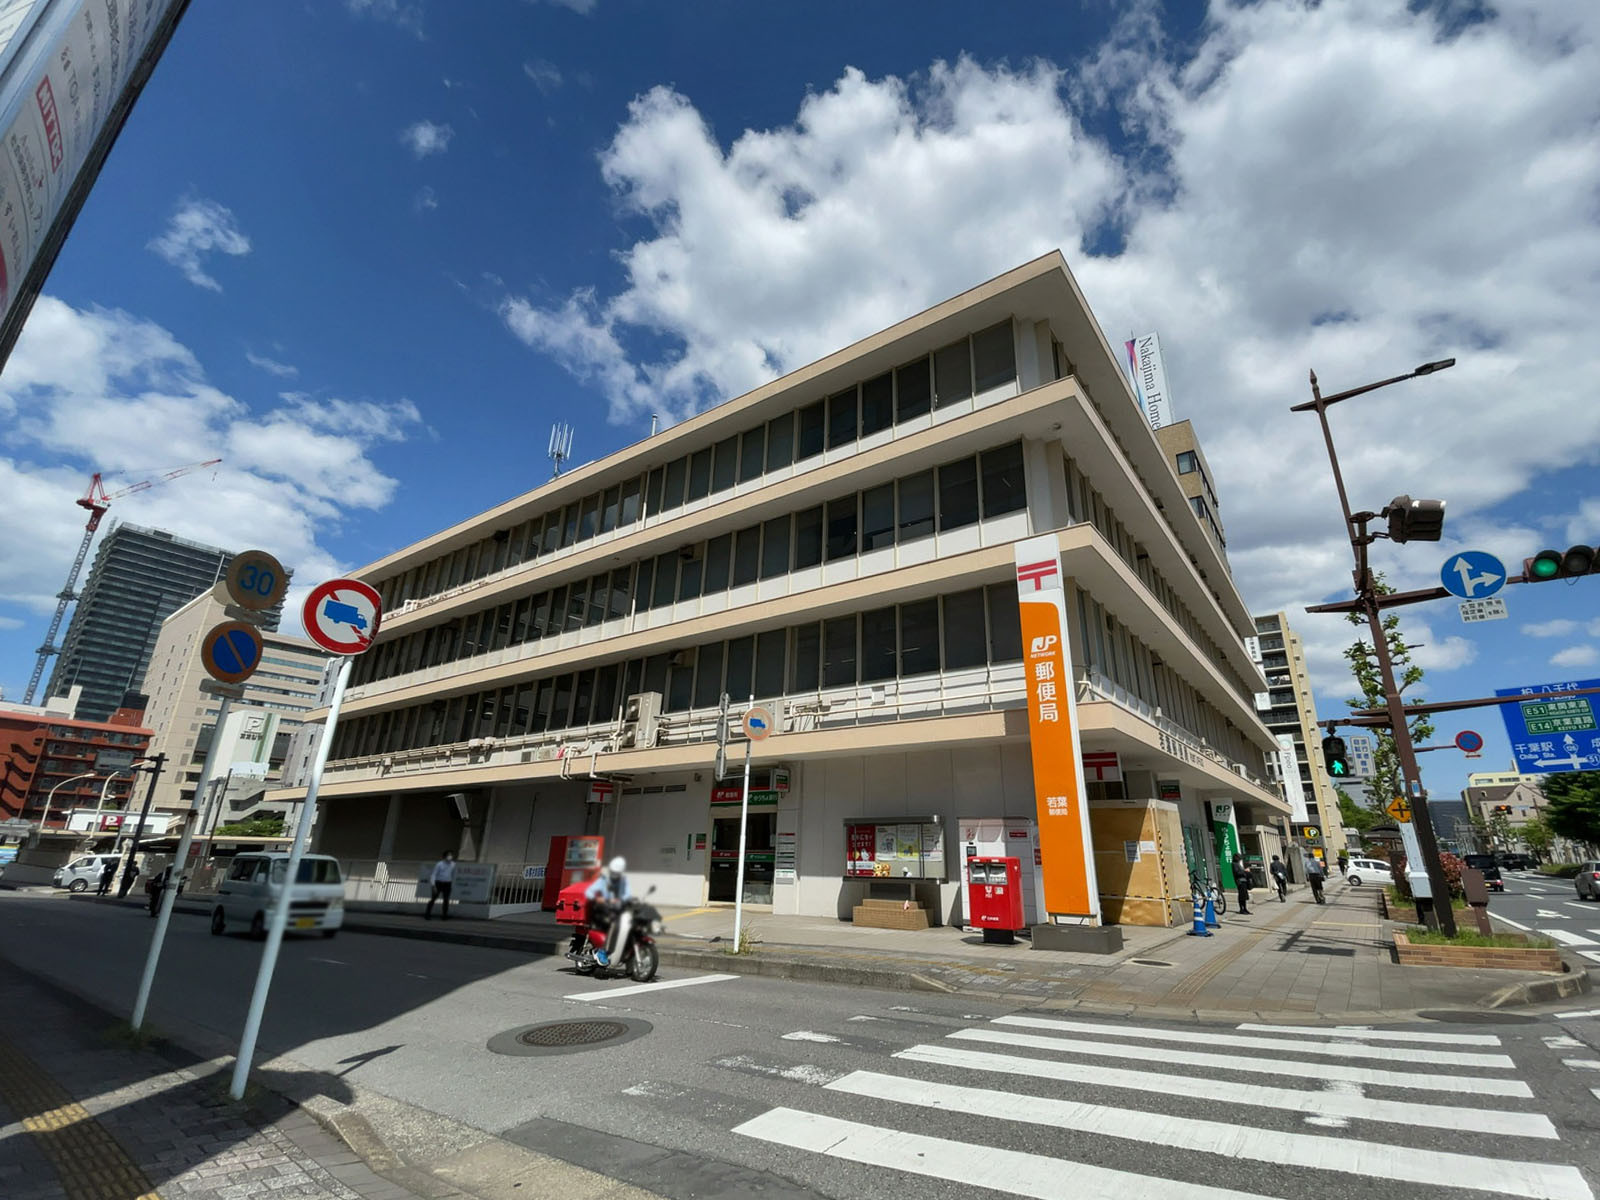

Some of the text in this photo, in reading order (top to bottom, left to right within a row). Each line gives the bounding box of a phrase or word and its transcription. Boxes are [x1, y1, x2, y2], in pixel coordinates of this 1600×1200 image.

[1139, 337, 1156, 391] Nakajima
[240, 565, 275, 596] 30
[1035, 661, 1059, 723] 郵便局
[1526, 707, 1545, 715] E51
[1531, 722, 1551, 731] E14
[1515, 741, 1555, 753] 千葉駅
